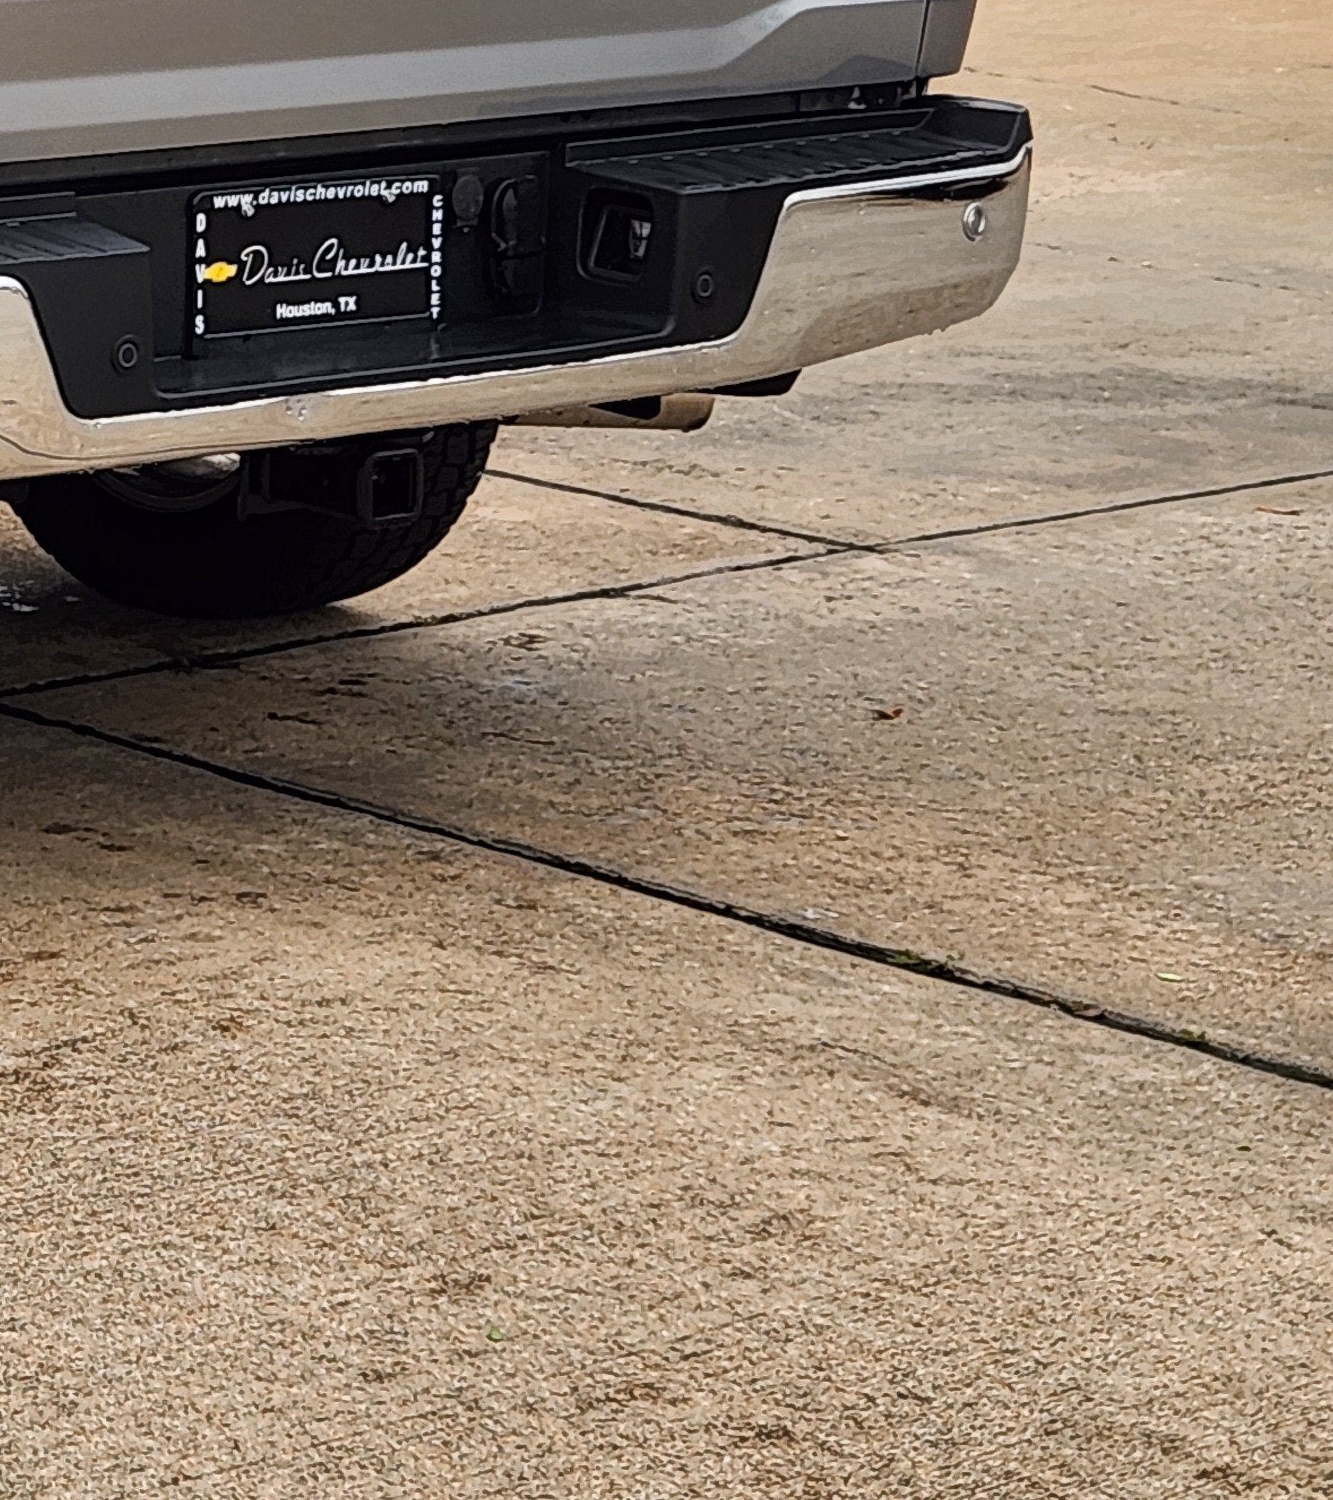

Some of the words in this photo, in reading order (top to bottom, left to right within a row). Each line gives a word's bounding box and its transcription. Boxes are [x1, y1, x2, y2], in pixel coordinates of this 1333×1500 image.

[213, 179, 429, 209] www.davischevrolet.com
[194, 212, 207, 335] DAVIS
[240, 244, 312, 285] Davis
[312, 237, 429, 279] Chevrolet
[431, 194, 444, 319] CHEVROLET
[275, 301, 335, 319] Houston,
[337, 296, 358, 311] TX
